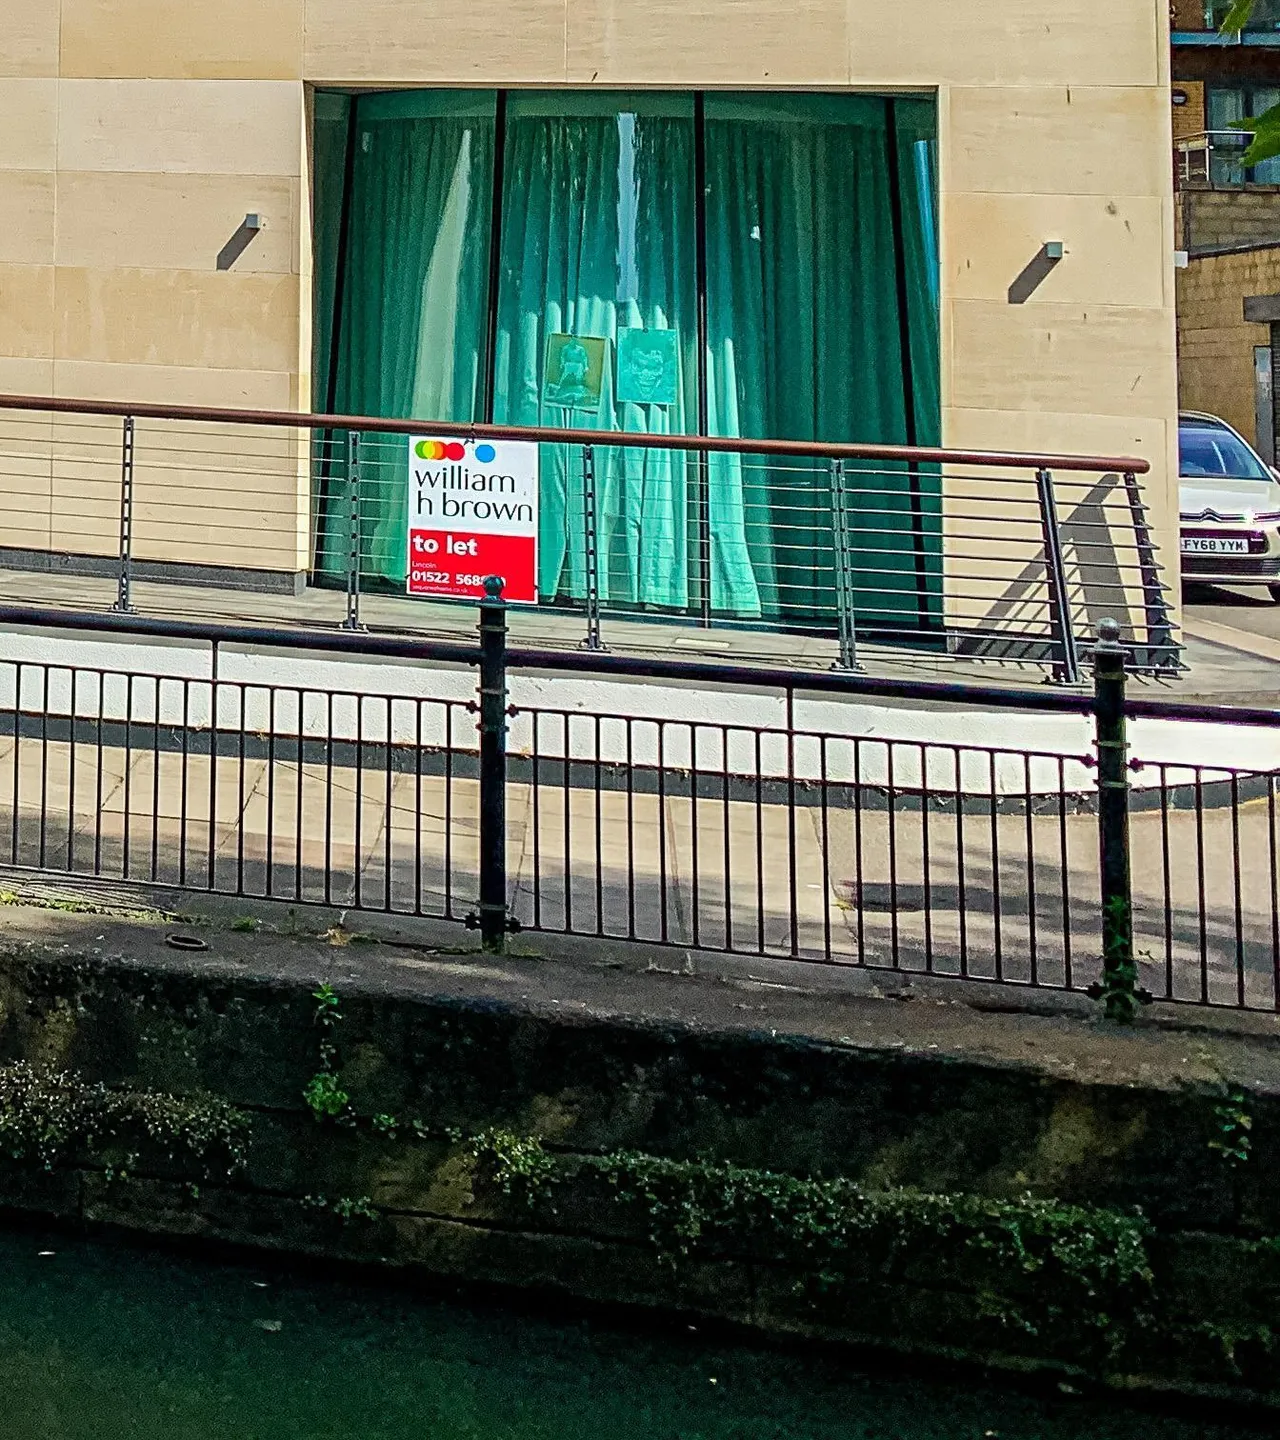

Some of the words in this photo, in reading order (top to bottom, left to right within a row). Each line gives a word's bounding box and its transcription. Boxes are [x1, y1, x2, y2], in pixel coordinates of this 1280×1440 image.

[414, 465, 516, 493] william
[417, 490, 433, 515] h
[442, 492, 533, 522] brown
[412, 534, 439, 553] to
[446, 535, 478, 556] let
[1184, 539, 1217, 550] FY68
[1219, 540, 1244, 551] YYM
[411, 570, 450, 584] 01522
[455, 573, 507, 588] 568
